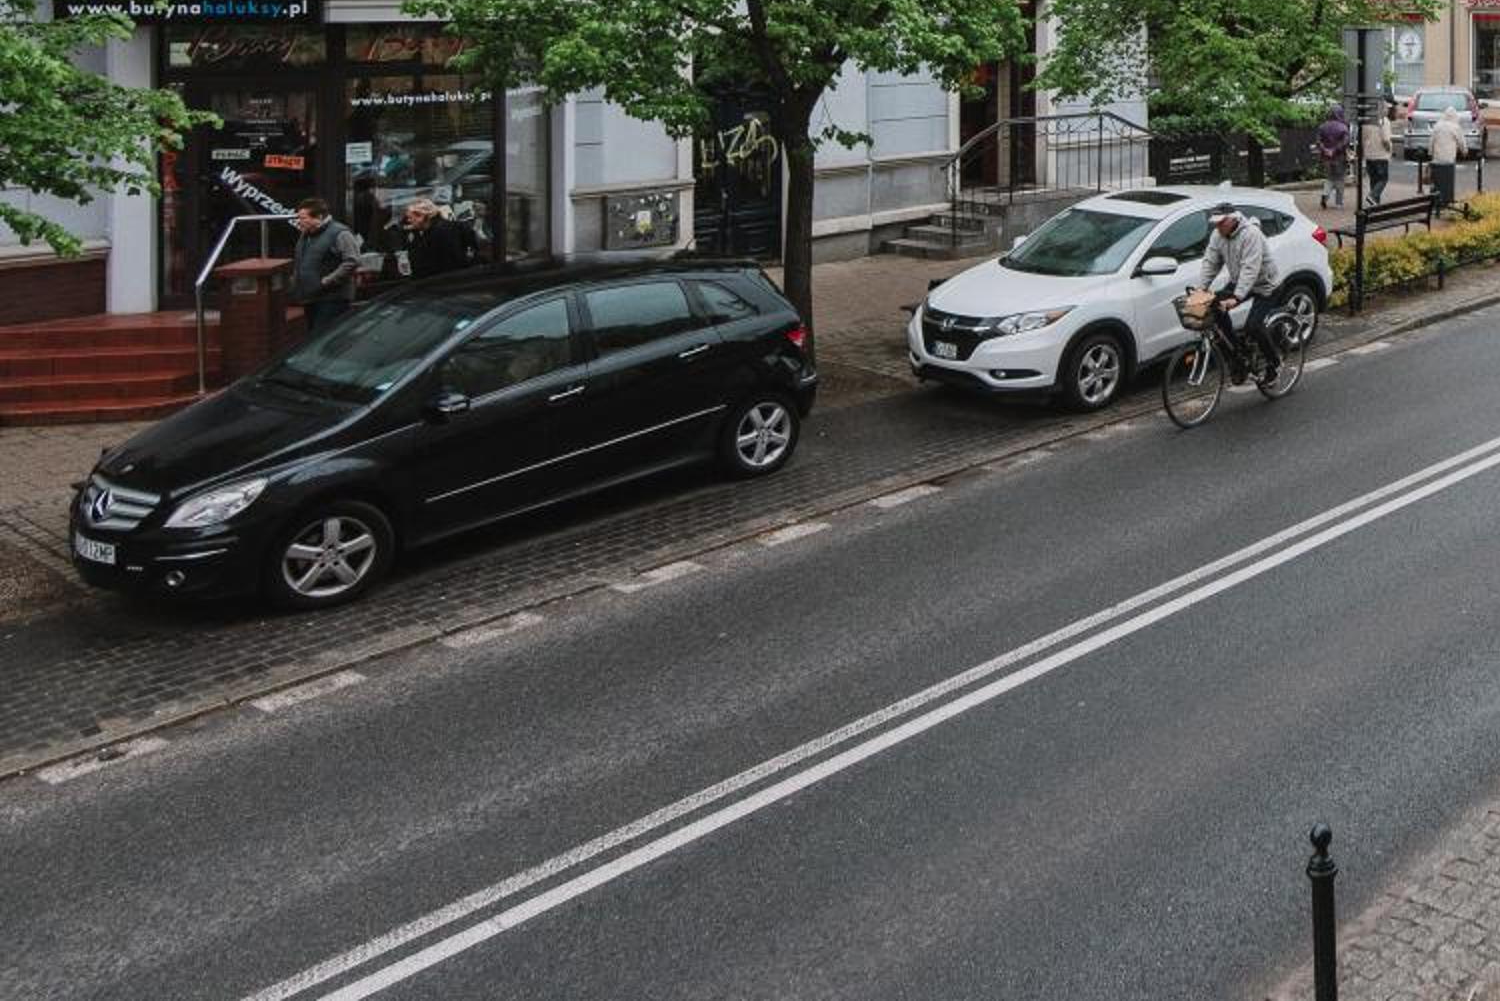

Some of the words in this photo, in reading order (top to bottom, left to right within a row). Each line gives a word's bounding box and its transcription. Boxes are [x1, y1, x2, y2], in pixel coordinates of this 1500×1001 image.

[67, 0, 308, 19] www.buynahaluksy.pl
[351, 91, 492, 107] www.butynahaluksypl
[220, 166, 301, 230] Wyprzed
